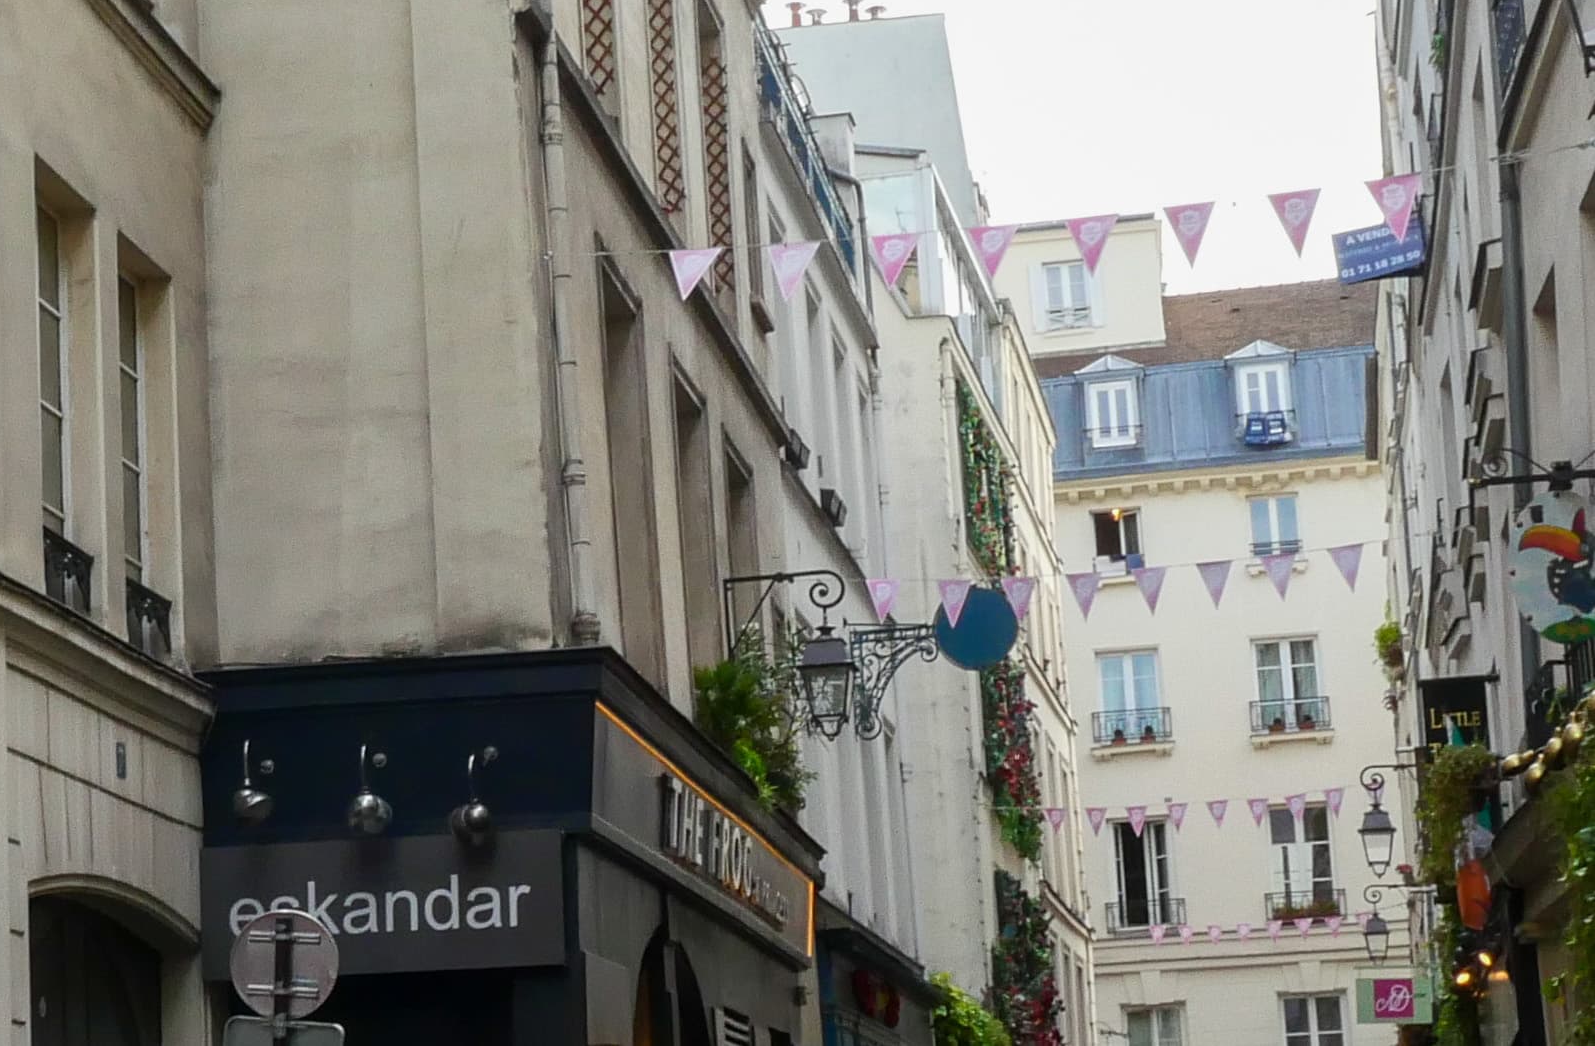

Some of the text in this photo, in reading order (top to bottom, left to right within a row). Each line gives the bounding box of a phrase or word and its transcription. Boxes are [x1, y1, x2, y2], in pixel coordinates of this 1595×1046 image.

[1356, 227, 1390, 242] VEND
[1357, 264, 1371, 274] 71
[670, 777, 704, 866] THE
